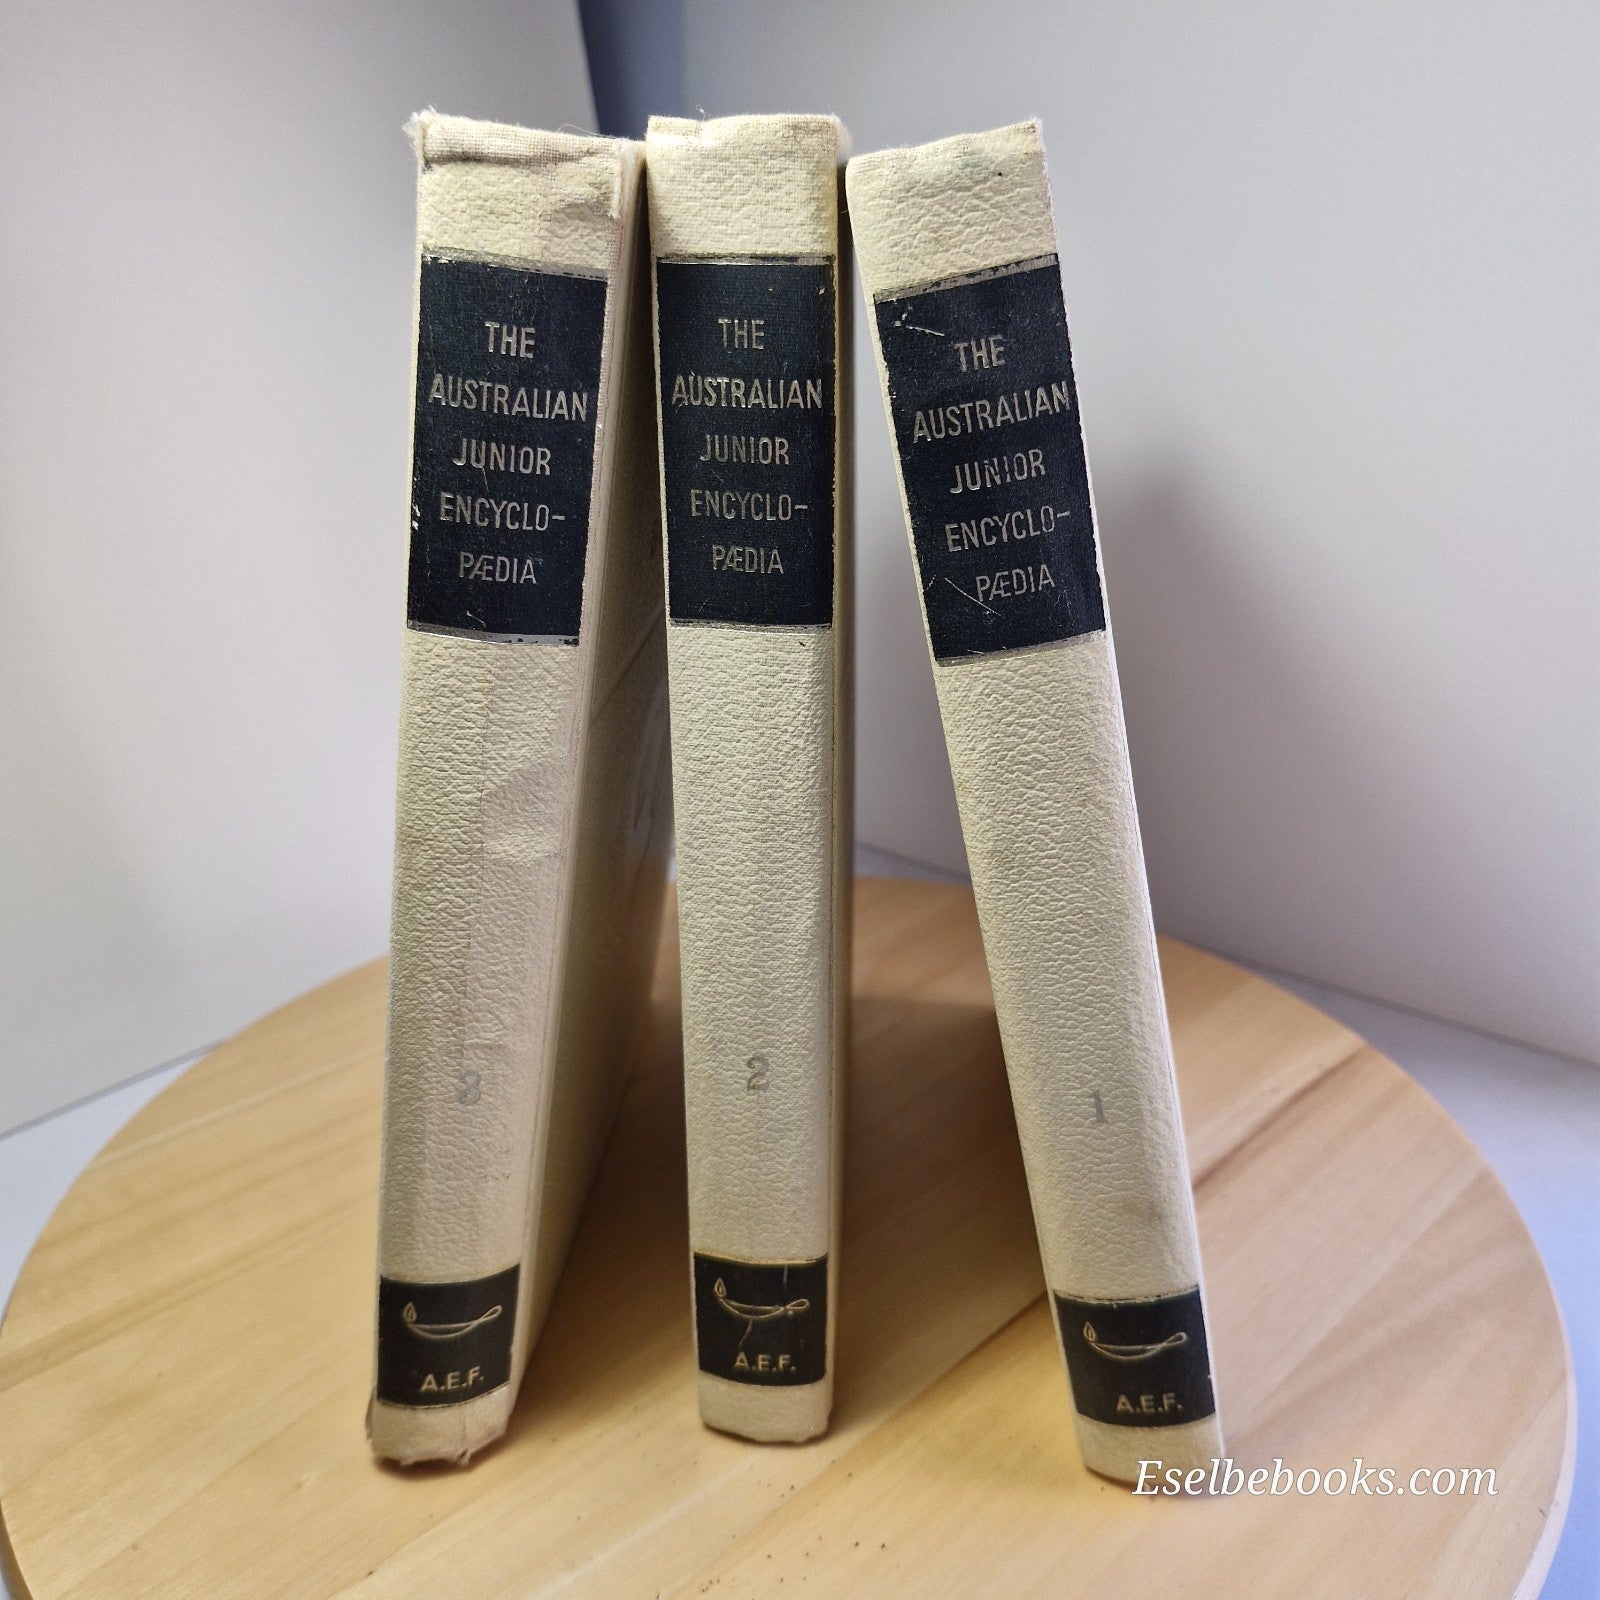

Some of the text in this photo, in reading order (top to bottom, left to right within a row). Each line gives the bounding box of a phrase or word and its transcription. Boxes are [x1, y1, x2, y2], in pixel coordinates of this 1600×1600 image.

[484, 321, 536, 359] THE
[718, 318, 765, 350] THE
[954, 335, 1006, 372] THE
[428, 373, 588, 422] AUSTRALIAN
[672, 375, 823, 409] AUSTRALIAN
[913, 380, 1071, 443] AUSTRALIAN
[452, 437, 551, 476] JUNIOR
[700, 434, 790, 465] JUNIOR
[950, 449, 1046, 494] JUNIOR
[439, 492, 566, 531] ENCYCLO-
[690, 489, 808, 521] ENCYCLO-
[944, 505, 1071, 552] ENCYCLO-
[458, 551, 538, 585] PÆDIA
[712, 544, 784, 575] PÆDIA
[976, 564, 1055, 602] PÆDIA
[746, 1055, 770, 1093] 2
[1091, 1090, 1106, 1125] 1
[420, 1366, 485, 1392] A.E.F.
[733, 1351, 797, 1372] A.E.F.
[1115, 1393, 1183, 1414] A.E.F.
